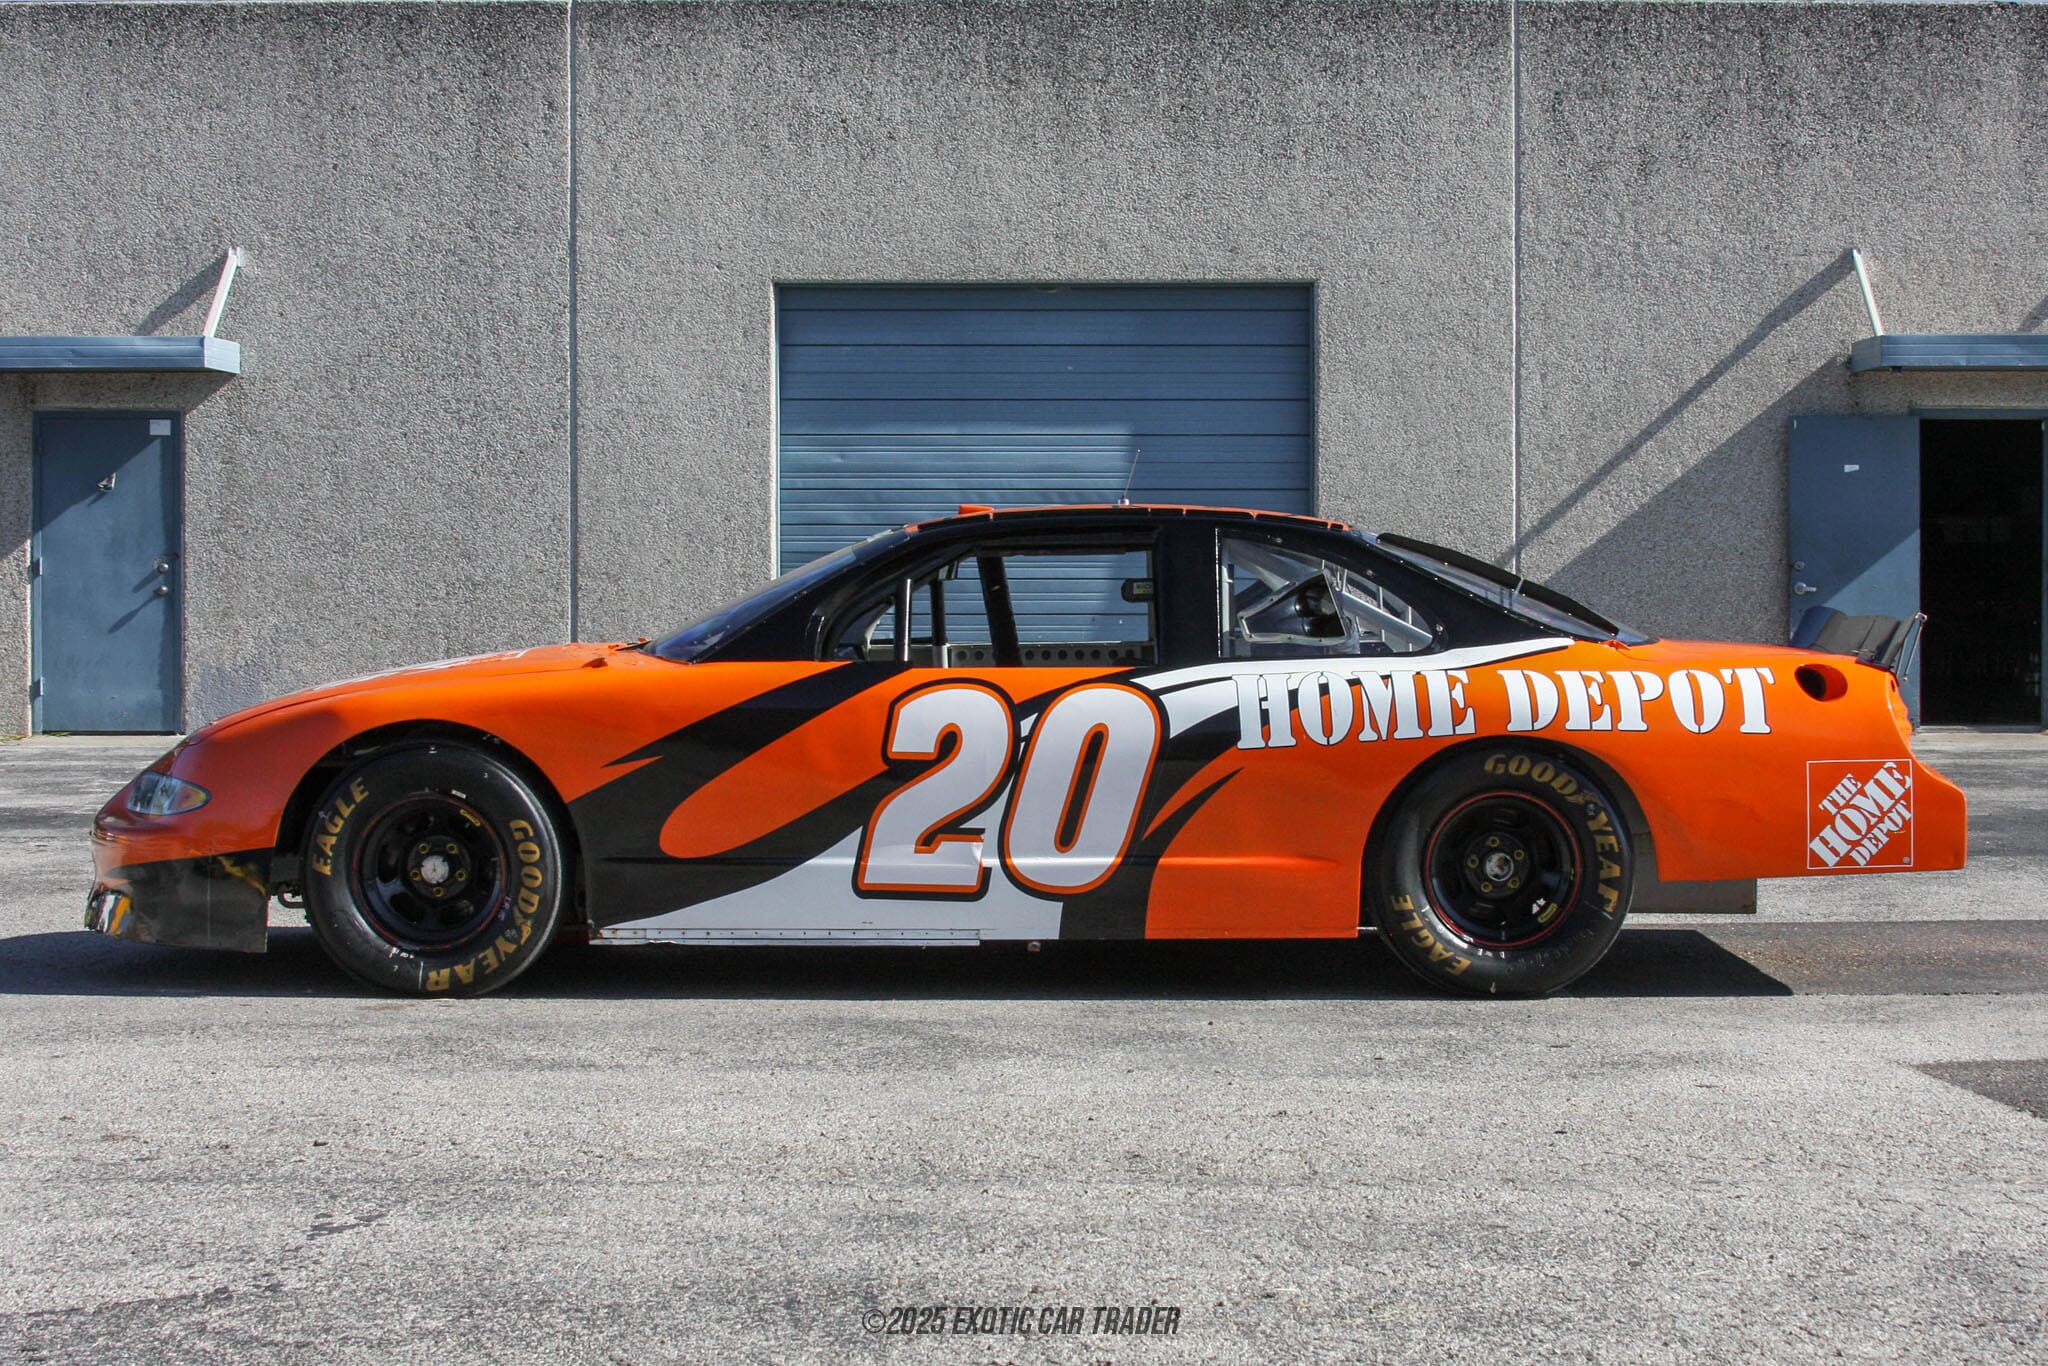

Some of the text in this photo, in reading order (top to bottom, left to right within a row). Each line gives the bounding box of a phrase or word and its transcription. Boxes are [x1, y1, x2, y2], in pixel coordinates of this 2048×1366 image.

[1231, 668, 1776, 749] HOME DEPOT
[313, 777, 369, 876] EAGLE
[863, 677, 1171, 902] 20
[1809, 761, 1911, 867] HOME
[1818, 773, 1862, 815] THE
[1849, 800, 1912, 866] DEPOT
[1392, 894, 1472, 976] EAGLE
